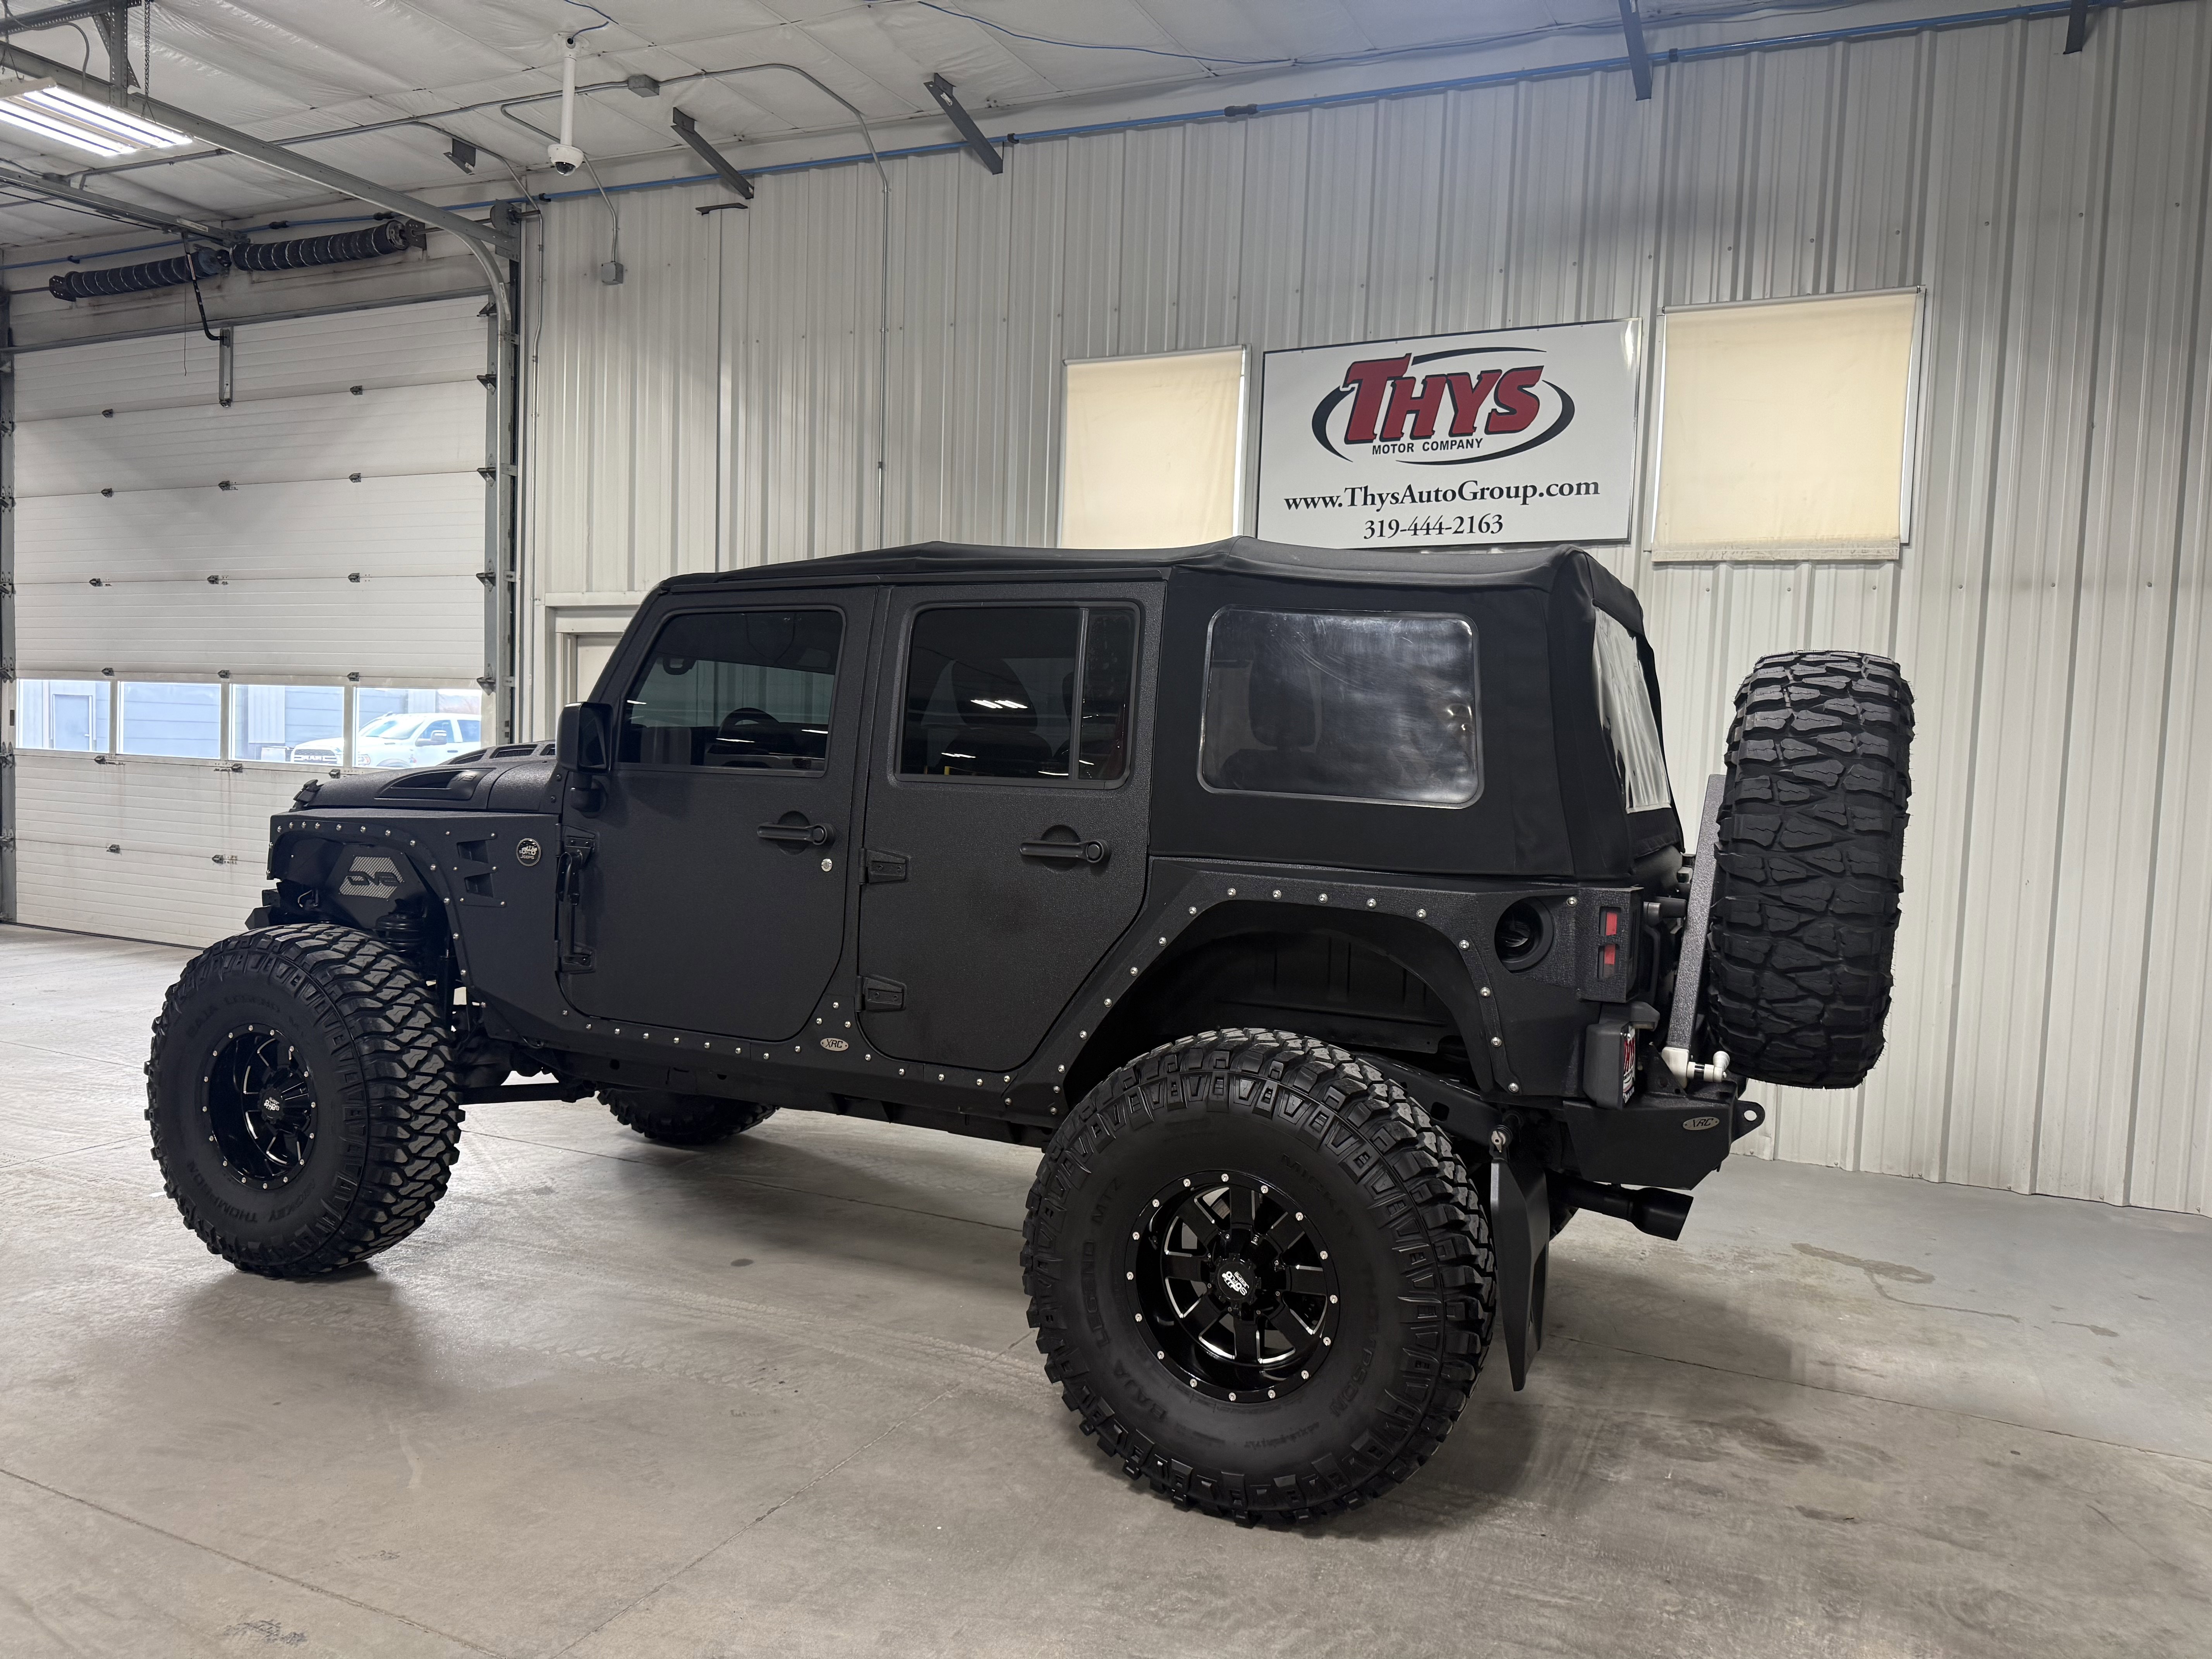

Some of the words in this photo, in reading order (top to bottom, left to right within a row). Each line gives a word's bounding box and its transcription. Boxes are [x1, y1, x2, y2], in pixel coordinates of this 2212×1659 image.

[1344, 353, 1544, 445] THYS
[1372, 442, 1414, 455] MOTOR
[1422, 438, 1483, 452] COMPANY
[1283, 479, 1601, 512] www.ThysAutoGroup.com
[1363, 513, 1504, 540] 319-444-2163
[826, 1039, 843, 1048] XRC
[1091, 1176, 1126, 1226] MTZ
[1280, 1153, 1359, 1239] MICKEY
[1080, 1241, 1110, 1349] LEGEND
[1113, 1358, 1167, 1422] BAJA
